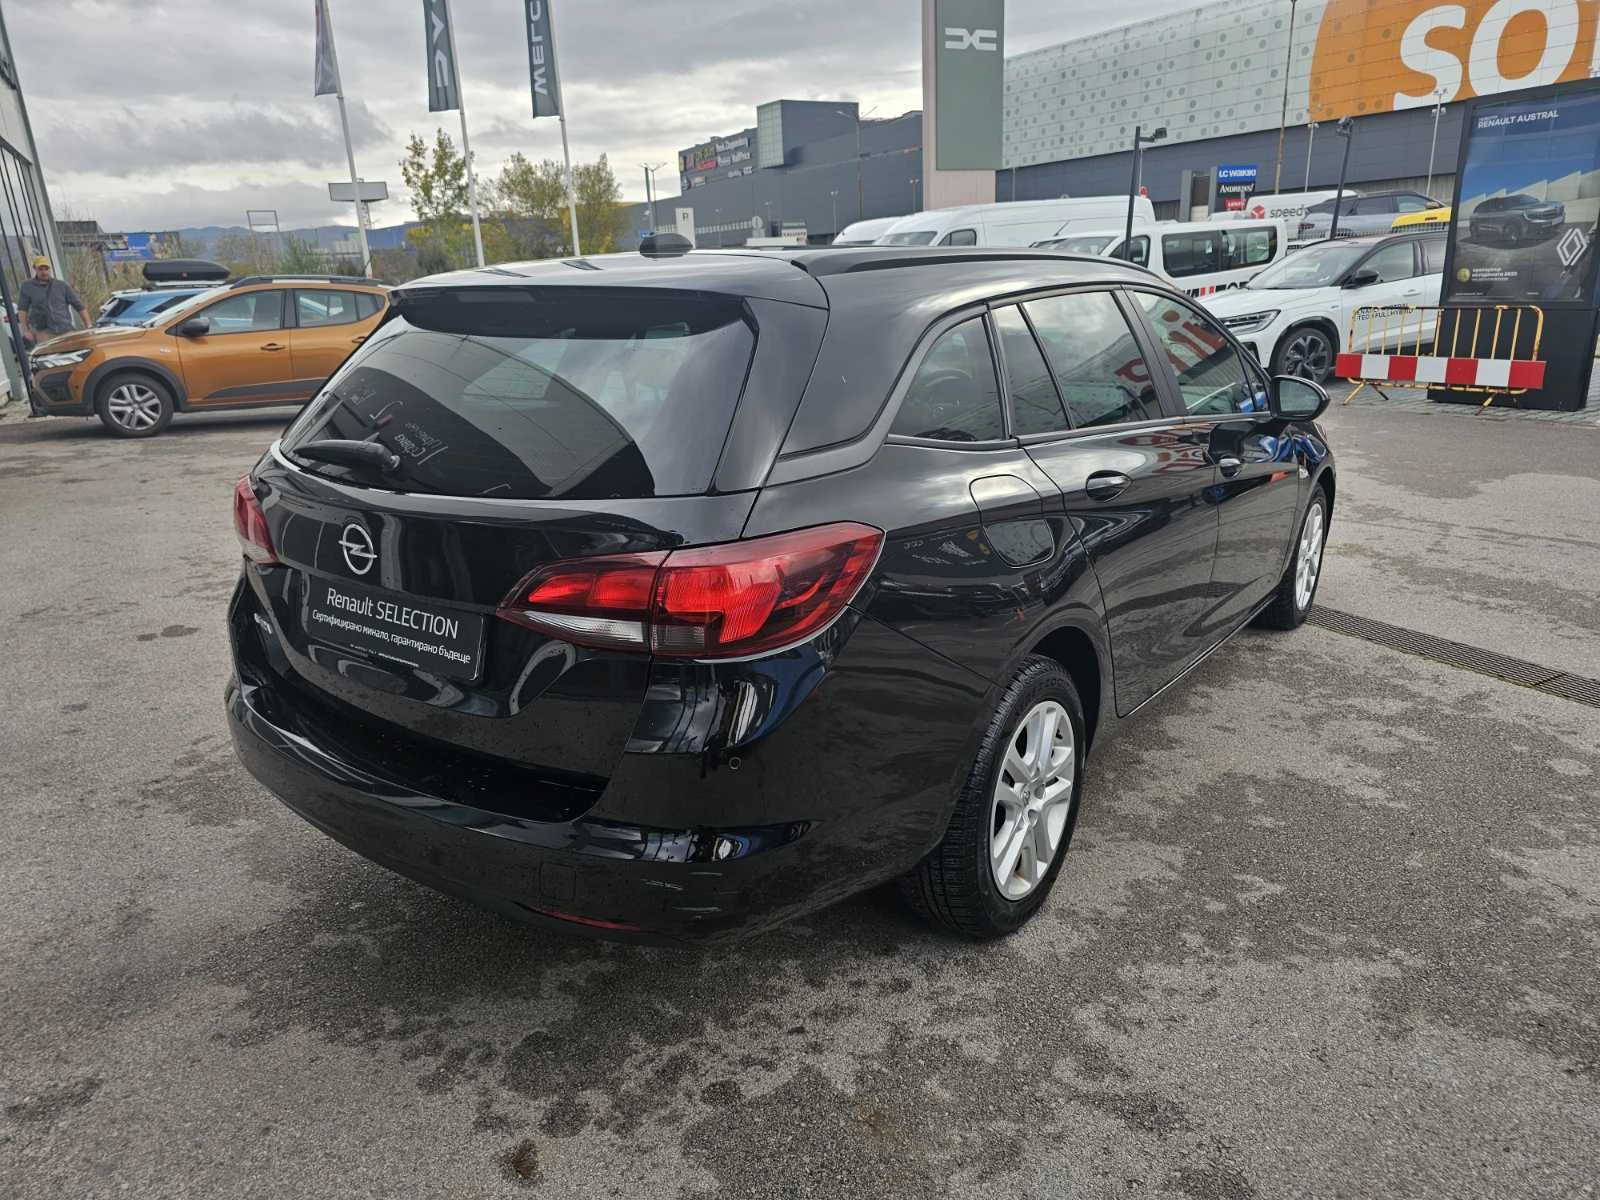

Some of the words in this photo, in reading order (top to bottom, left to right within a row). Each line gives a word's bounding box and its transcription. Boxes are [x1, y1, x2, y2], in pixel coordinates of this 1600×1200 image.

[1393, 0, 1600, 110] SO
[1477, 115, 1517, 129] RENAULT
[1516, 109, 1560, 123] AUSTRAL
[1269, 203, 1305, 219] speed
[312, 609, 363, 634] Сертифицирано
[362, 624, 391, 642] минало,
[390, 633, 438, 655] гарантирано
[438, 644, 472, 665] бъдеще
[326, 587, 373, 617] Renault
[375, 601, 459, 640] SELECTION
